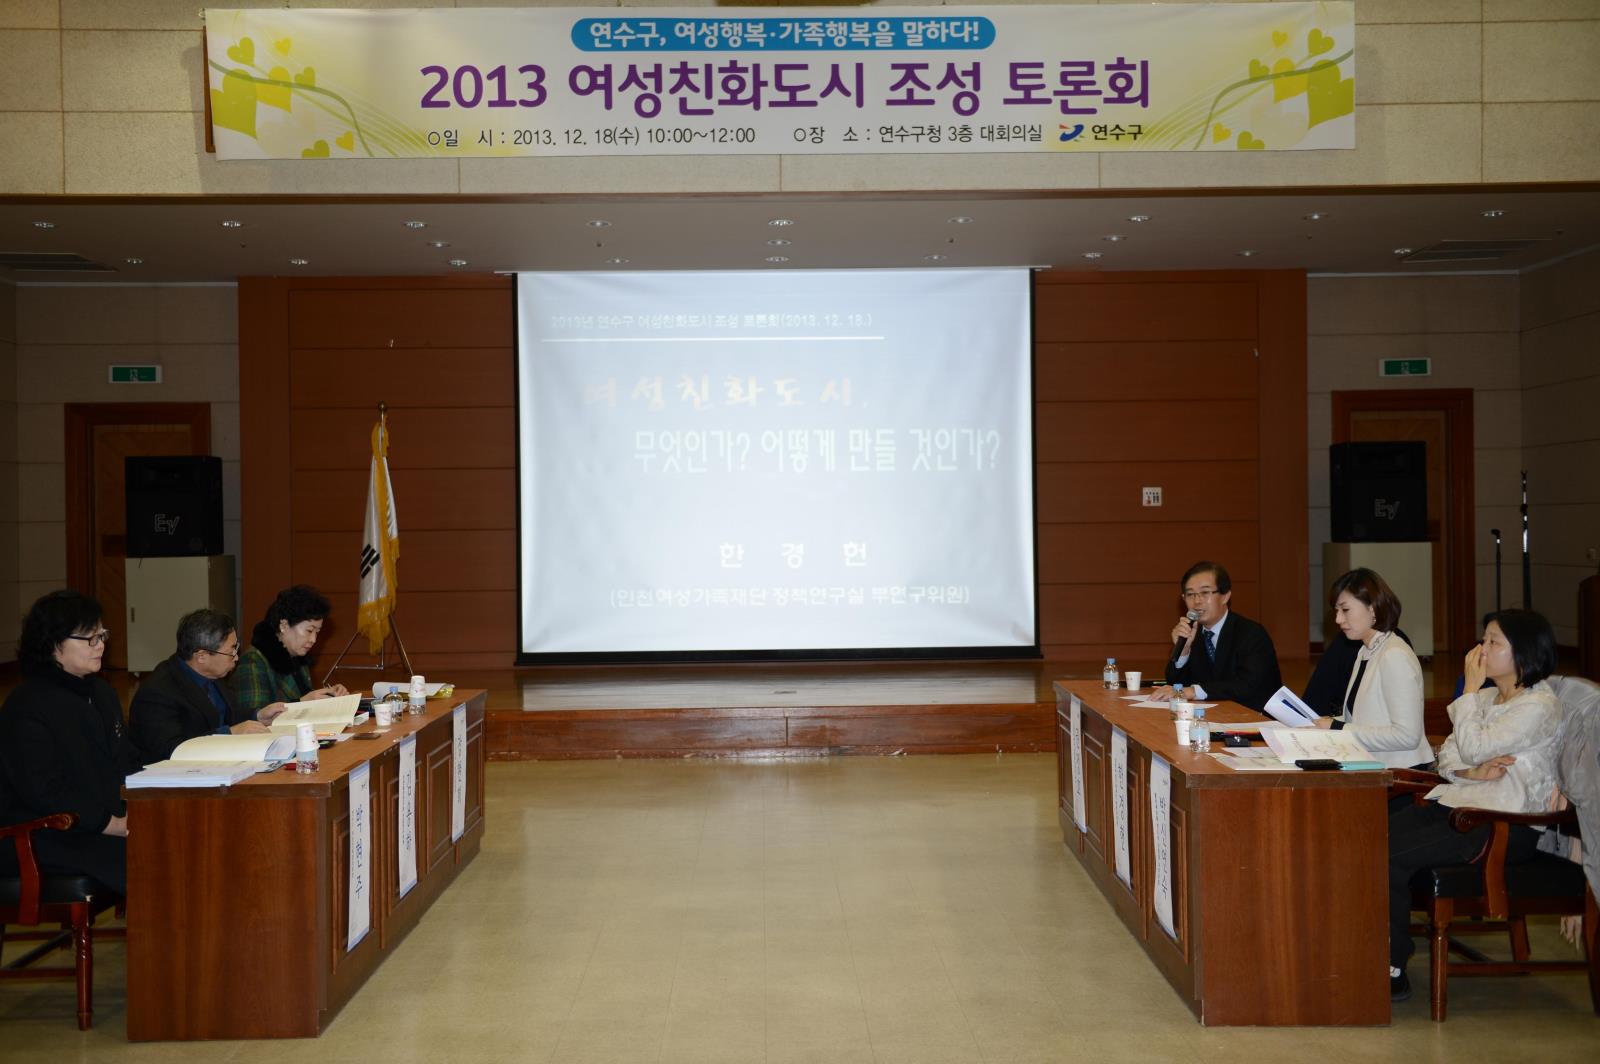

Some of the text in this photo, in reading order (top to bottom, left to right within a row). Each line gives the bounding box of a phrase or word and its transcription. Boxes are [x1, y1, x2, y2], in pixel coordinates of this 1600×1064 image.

[589, 20, 979, 48] 연수구, 여성행복·가족행복을 말하다!
[420, 57, 1149, 119] 2013 여성친화도시 조성 토론회
[513, 129, 557, 146] 2013.
[564, 129, 587, 146] 12.
[594, 127, 640, 146] 18(수)
[878, 125, 942, 143] 연수구청
[948, 125, 973, 142] 3층
[980, 124, 1042, 142] 대회의실
[1091, 124, 1144, 141] 연수구
[634, 428, 1001, 474] 무엇인가? 어떻게 만들 것인가?
